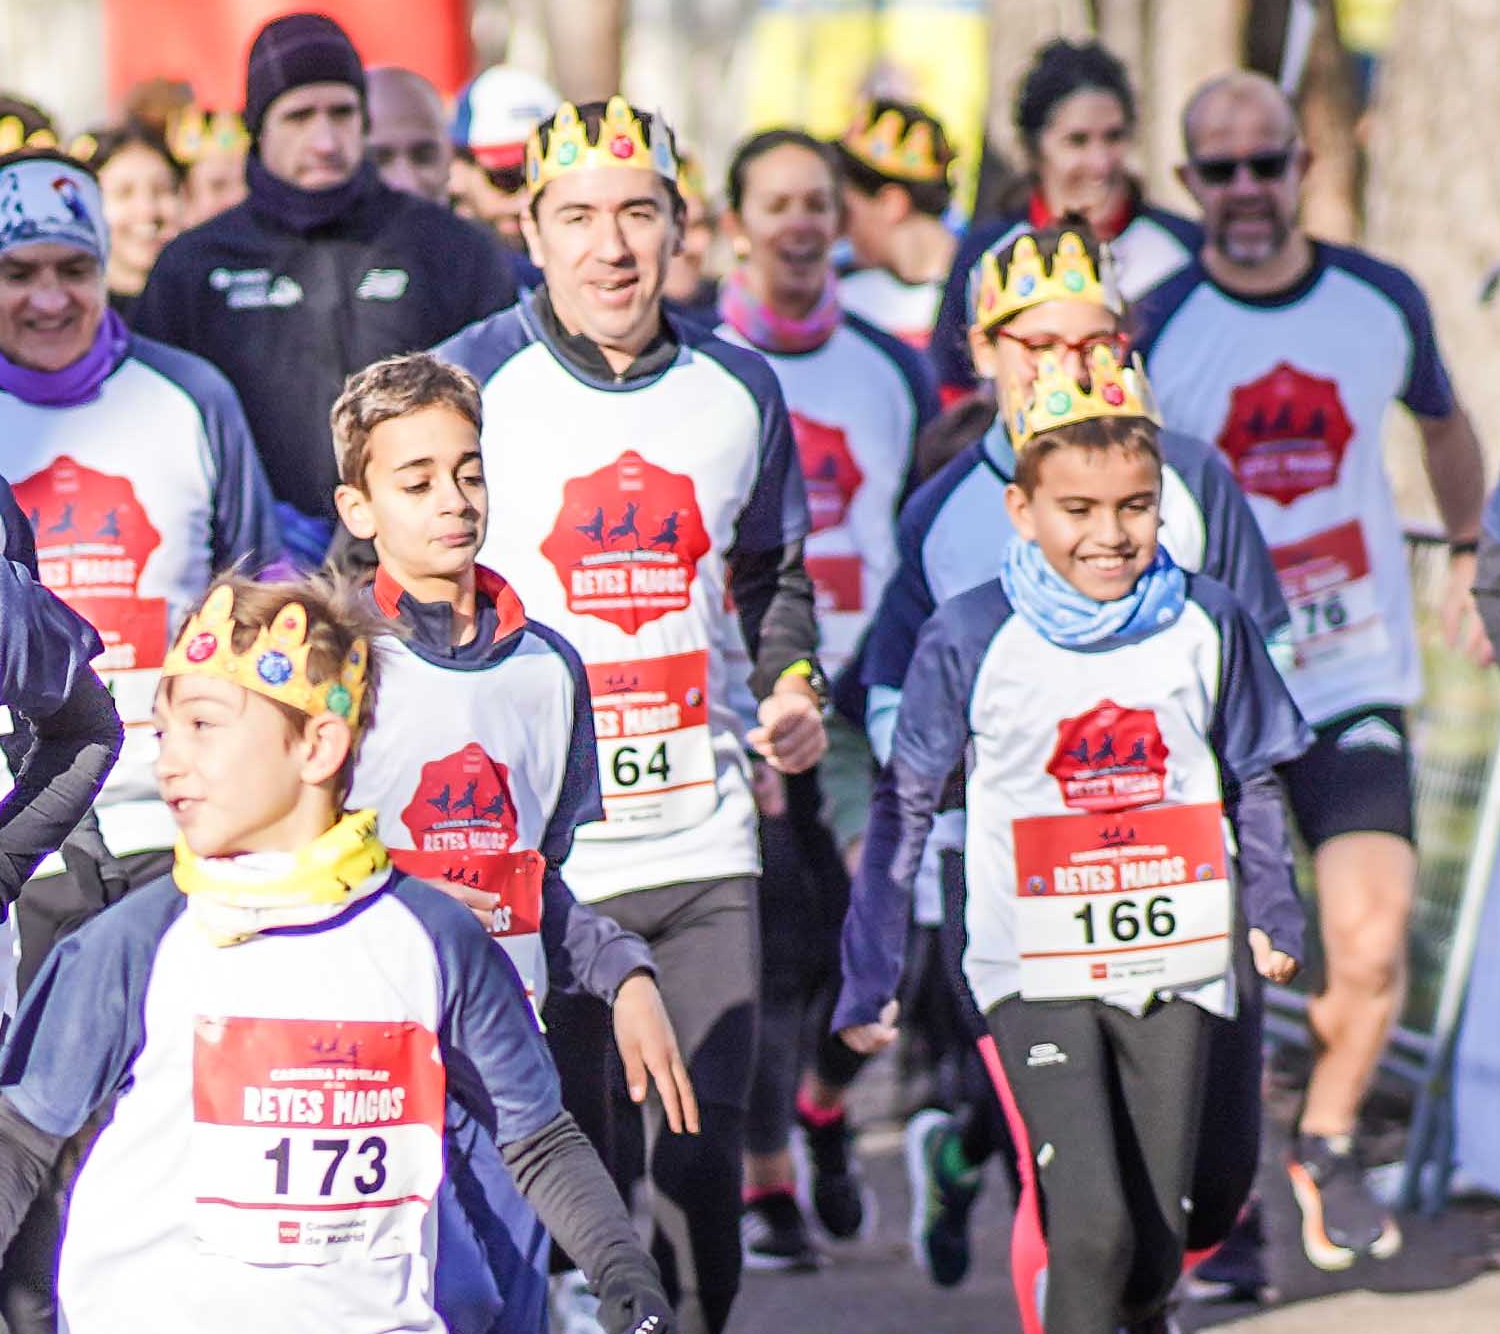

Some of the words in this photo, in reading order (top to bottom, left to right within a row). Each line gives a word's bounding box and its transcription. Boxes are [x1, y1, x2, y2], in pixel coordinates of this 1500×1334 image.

[1073, 894, 1177, 944] 166
[243, 1086, 325, 1124] REYES
[332, 1086, 406, 1125] MAGOS
[264, 1135, 388, 1196] 173
